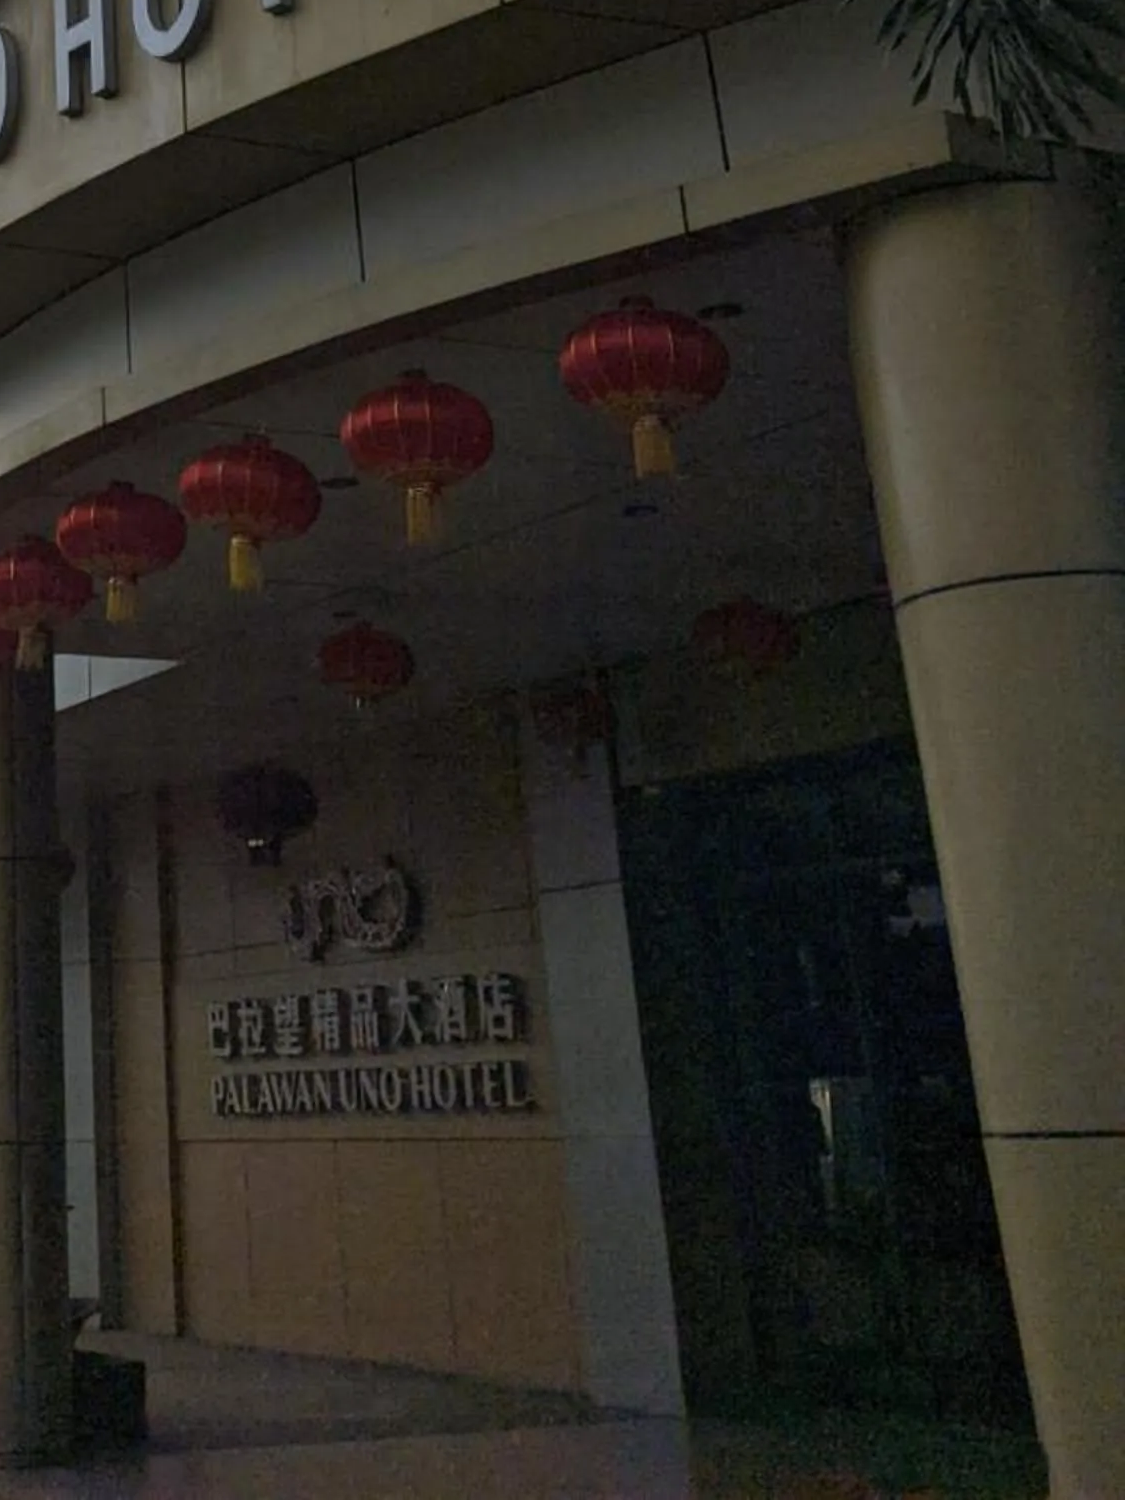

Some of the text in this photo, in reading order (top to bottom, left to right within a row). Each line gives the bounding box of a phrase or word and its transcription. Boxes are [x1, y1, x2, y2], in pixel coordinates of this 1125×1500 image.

[210, 1060, 533, 1116] PALAWAN UNO HOTEL
